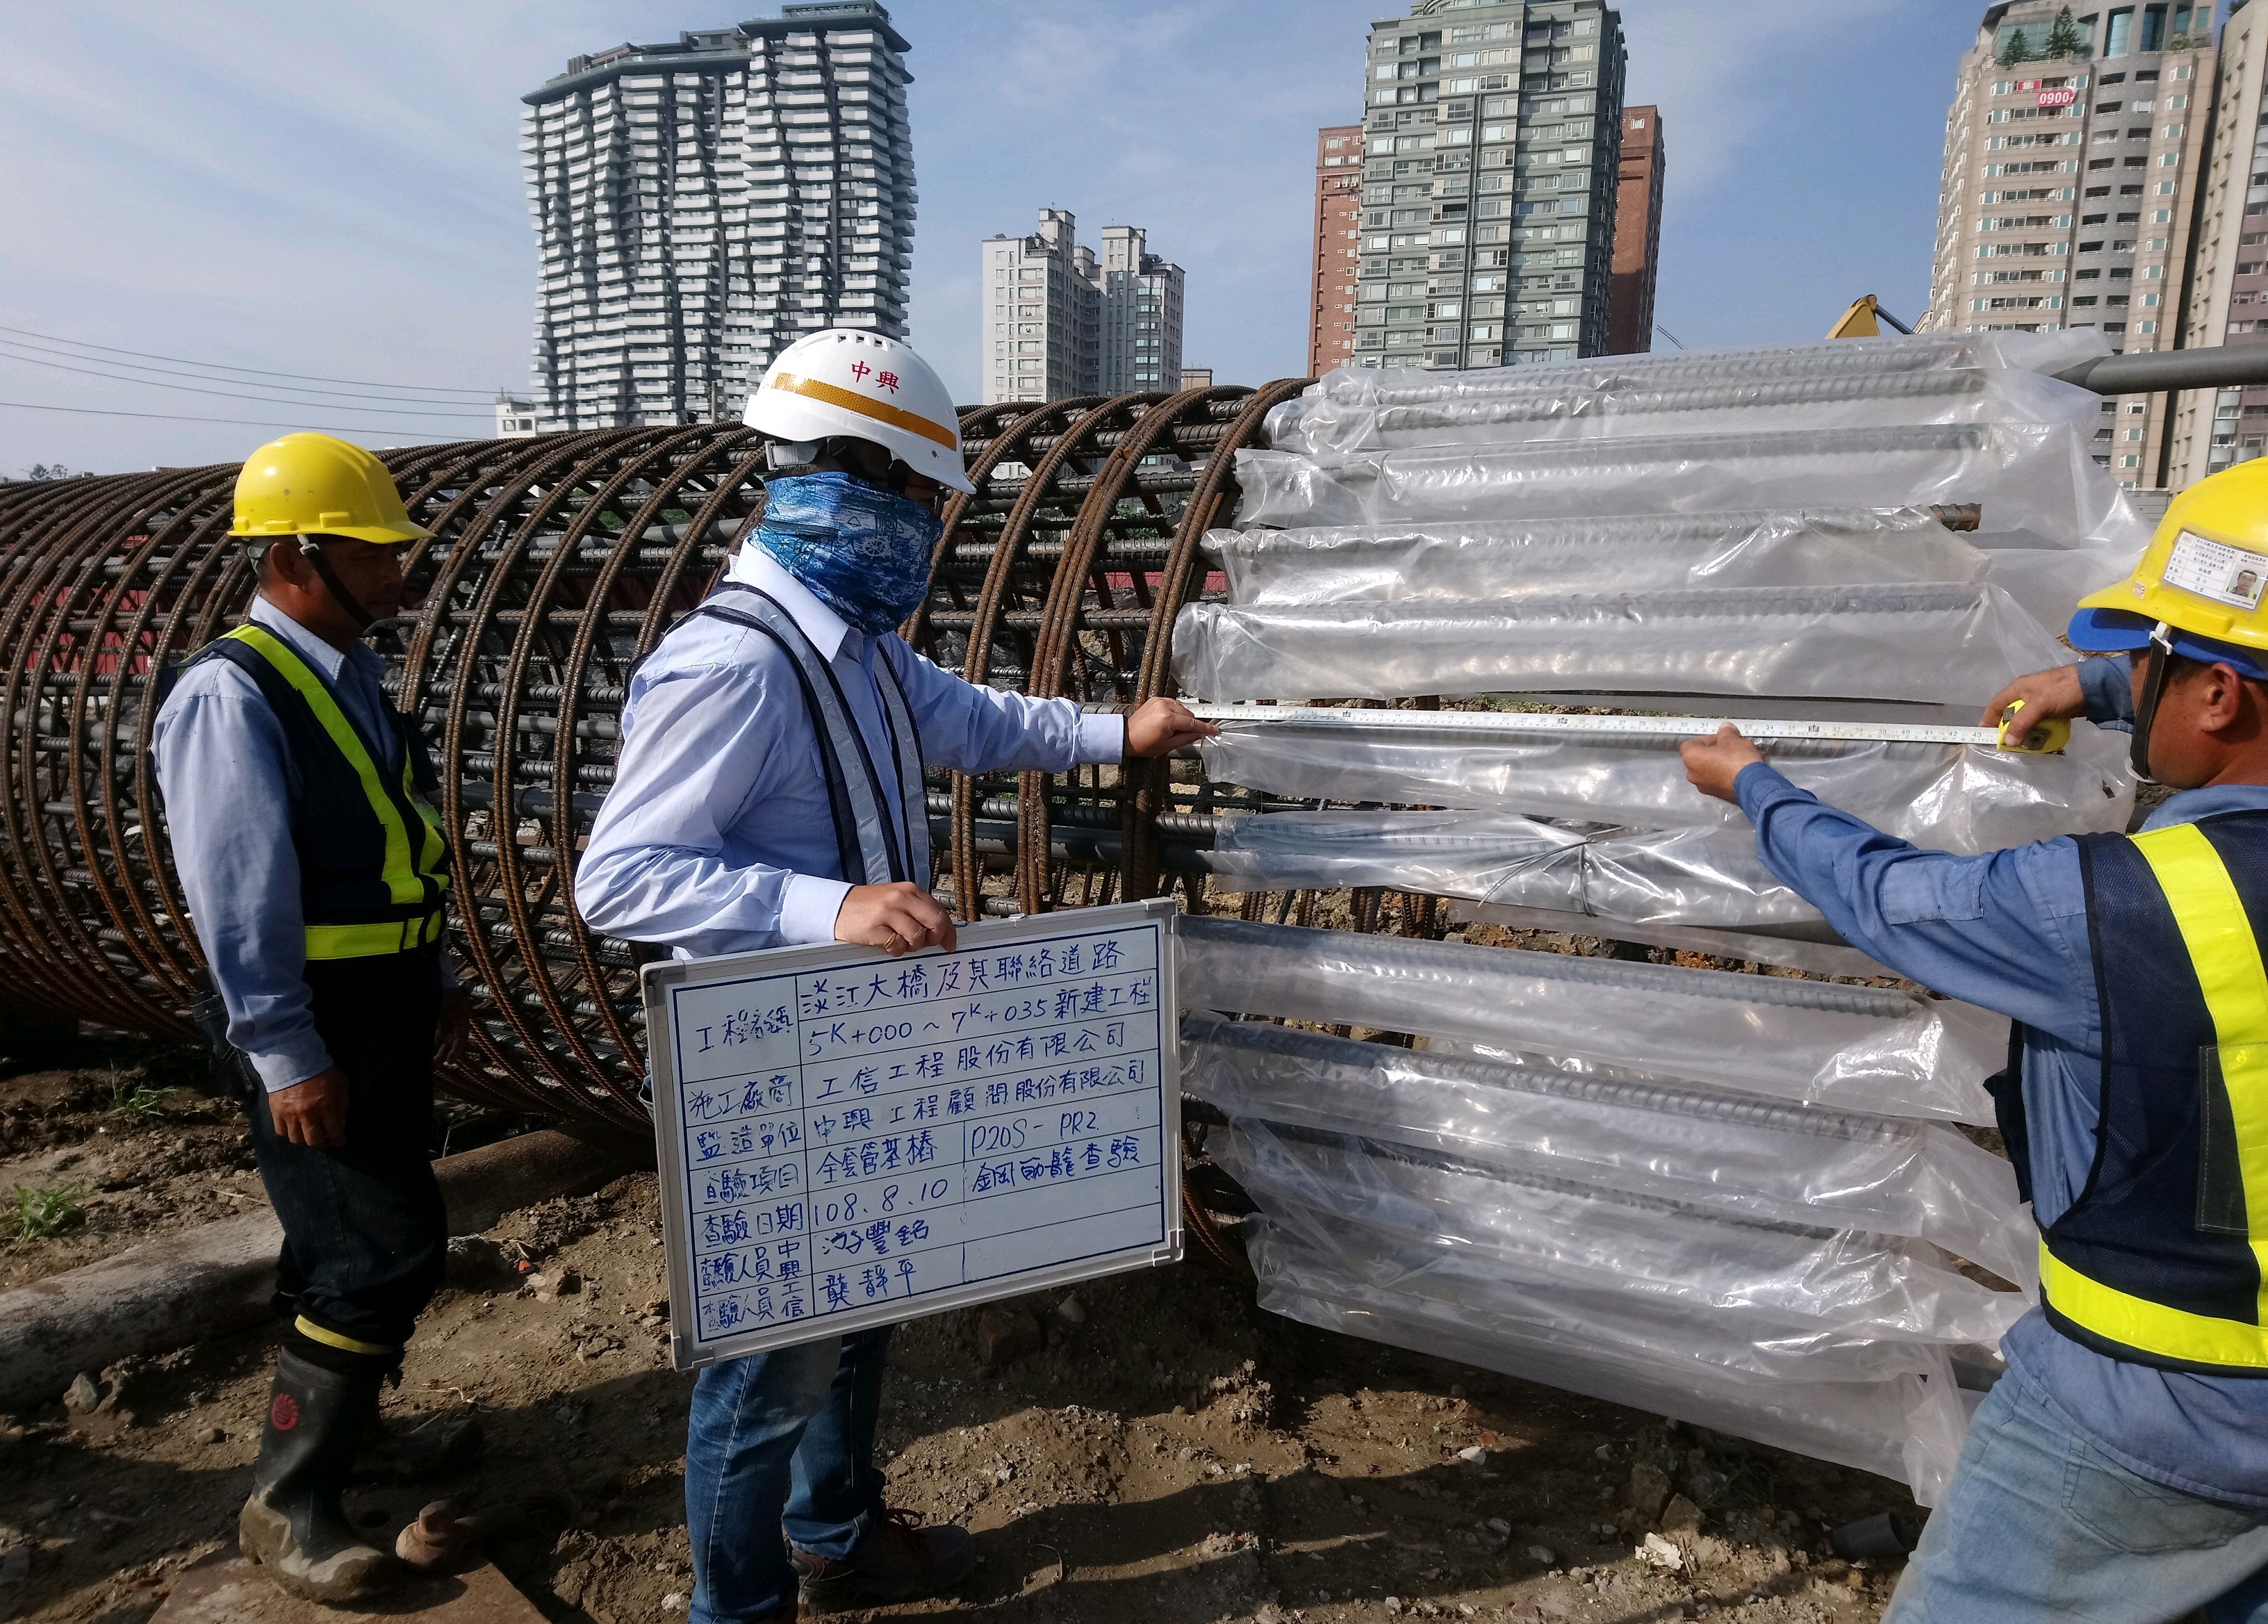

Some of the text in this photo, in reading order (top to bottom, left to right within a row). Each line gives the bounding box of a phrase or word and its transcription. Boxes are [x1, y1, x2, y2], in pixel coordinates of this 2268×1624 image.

[852, 360, 899, 395] 中興
[800, 940, 1126, 1015] 淡江大橋及其聯絡道路
[816, 1022, 1124, 1099] 工信工程股份有限公司
[688, 1074, 793, 1119] 施工廠商
[814, 1060, 1144, 1146] 中興工程顧問股份有限公司
[696, 1122, 802, 1162] 監造單位
[700, 1203, 803, 1248] 查驗日期
